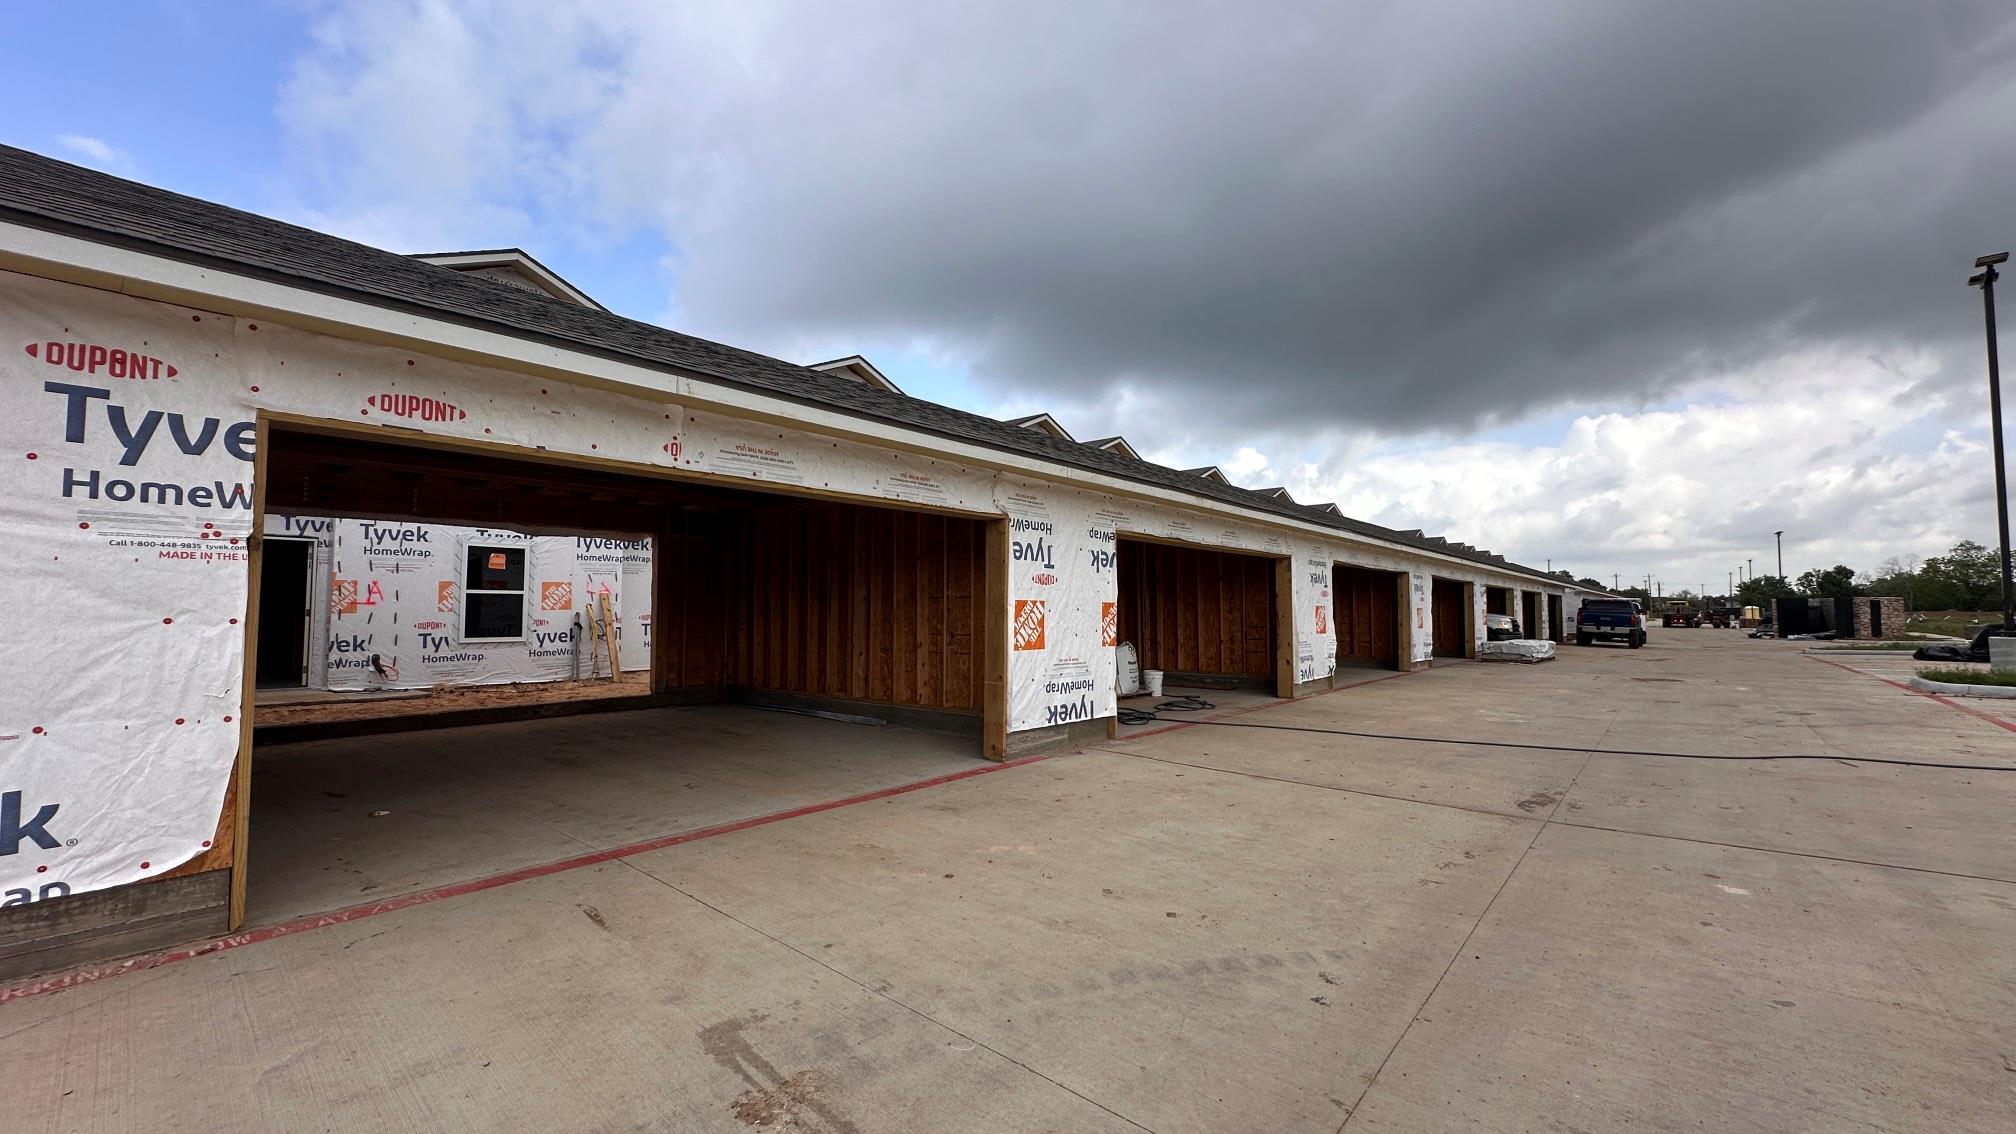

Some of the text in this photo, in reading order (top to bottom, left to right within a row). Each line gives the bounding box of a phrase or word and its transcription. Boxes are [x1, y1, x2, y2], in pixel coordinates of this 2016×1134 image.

[46, 342, 163, 380] DUPONT
[380, 393, 457, 422] DUPONT
[44, 381, 257, 466] Tyve
[62, 468, 254, 509] HomeW
[359, 523, 430, 545] Tyvek
[109, 539, 128, 547] Call
[129, 540, 202, 549] 1-800-448-9835
[363, 546, 431, 558] HomeWrap
[1012, 537, 1055, 569] Tyve
[159, 550, 197, 560] MADE
[200, 551, 213, 560] IN
[215, 552, 239, 561] THE
[1034, 573, 1055, 585] DUPONT
[417, 621, 443, 630] DUPONT
[1045, 679, 1094, 695] HomeWrap
